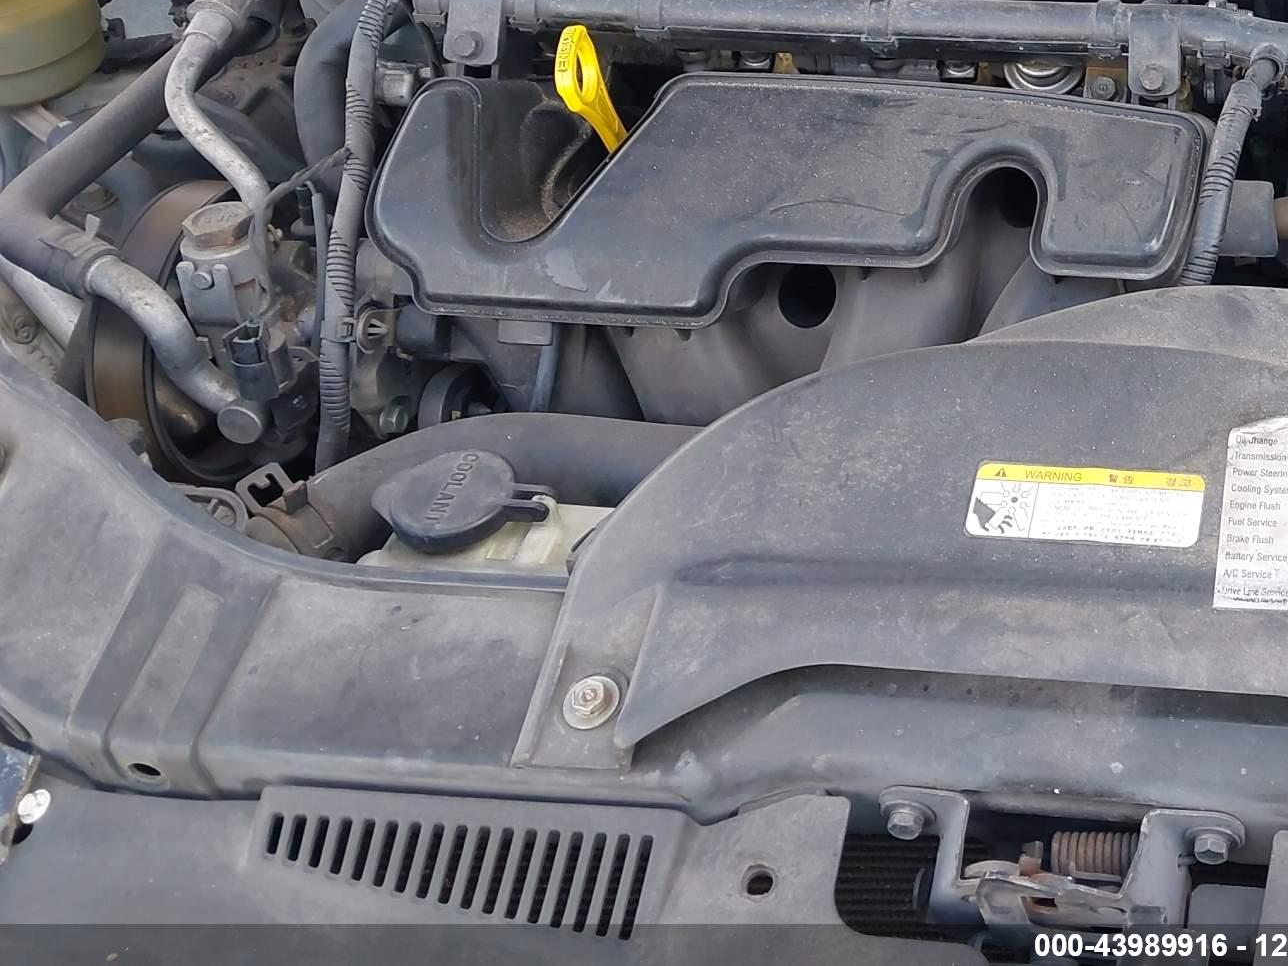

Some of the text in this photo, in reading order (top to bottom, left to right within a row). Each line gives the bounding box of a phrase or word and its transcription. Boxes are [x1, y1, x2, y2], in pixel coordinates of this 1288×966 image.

[1234, 451, 1287, 462] Transmission
[1024, 469, 1082, 482] WARNING
[1232, 467, 1259, 477] Power
[426, 453, 479, 525] COOLANT
[1231, 483, 1262, 495] Cooling
[1229, 500, 1281, 511] Engine Flush
[1228, 517, 1278, 528] Fuel Service
[1226, 533, 1274, 545] Brake Flush
[1224, 551, 1288, 563] Battery Service
[1241, 568, 1273, 579] Service
